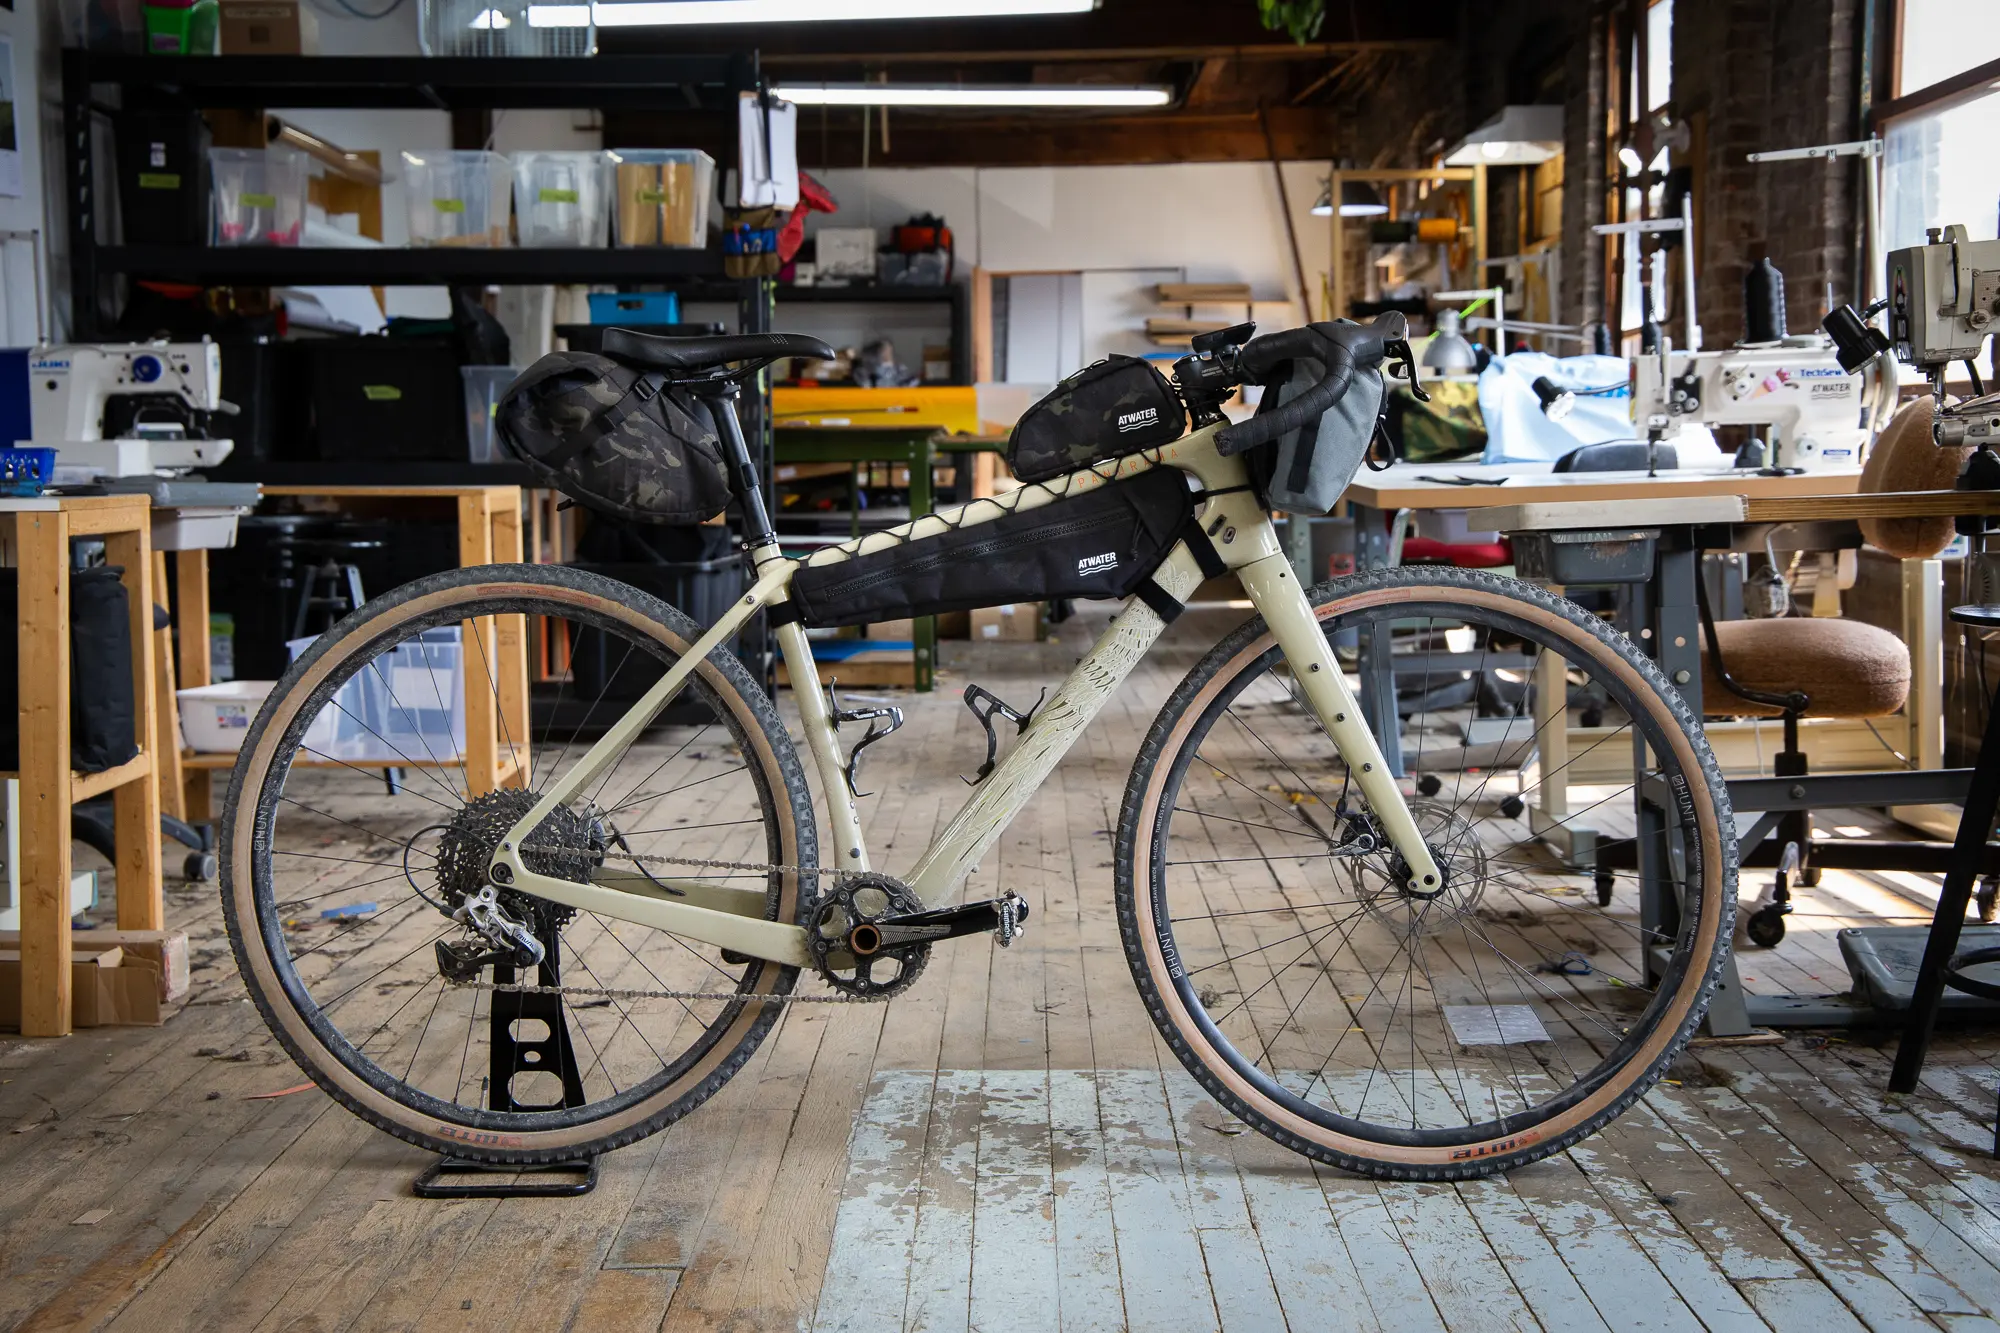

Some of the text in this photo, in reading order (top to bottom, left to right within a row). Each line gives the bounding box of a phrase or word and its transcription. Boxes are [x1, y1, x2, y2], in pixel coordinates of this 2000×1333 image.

[1811, 383, 1851, 393] ATWATER
[1118, 407, 1157, 426] ATWATER
[1078, 551, 1116, 569] ATWATER
[1155, 792, 1169, 833] TUBELESS READY
[1676, 785, 1696, 823] HUNT
[255, 805, 271, 839] HUNT
[1003, 905, 1011, 939] SHIMANO
[1159, 932, 1178, 968] HUNT
[440, 1126, 498, 1144] WTB
[1453, 1139, 1516, 1159] WTB
